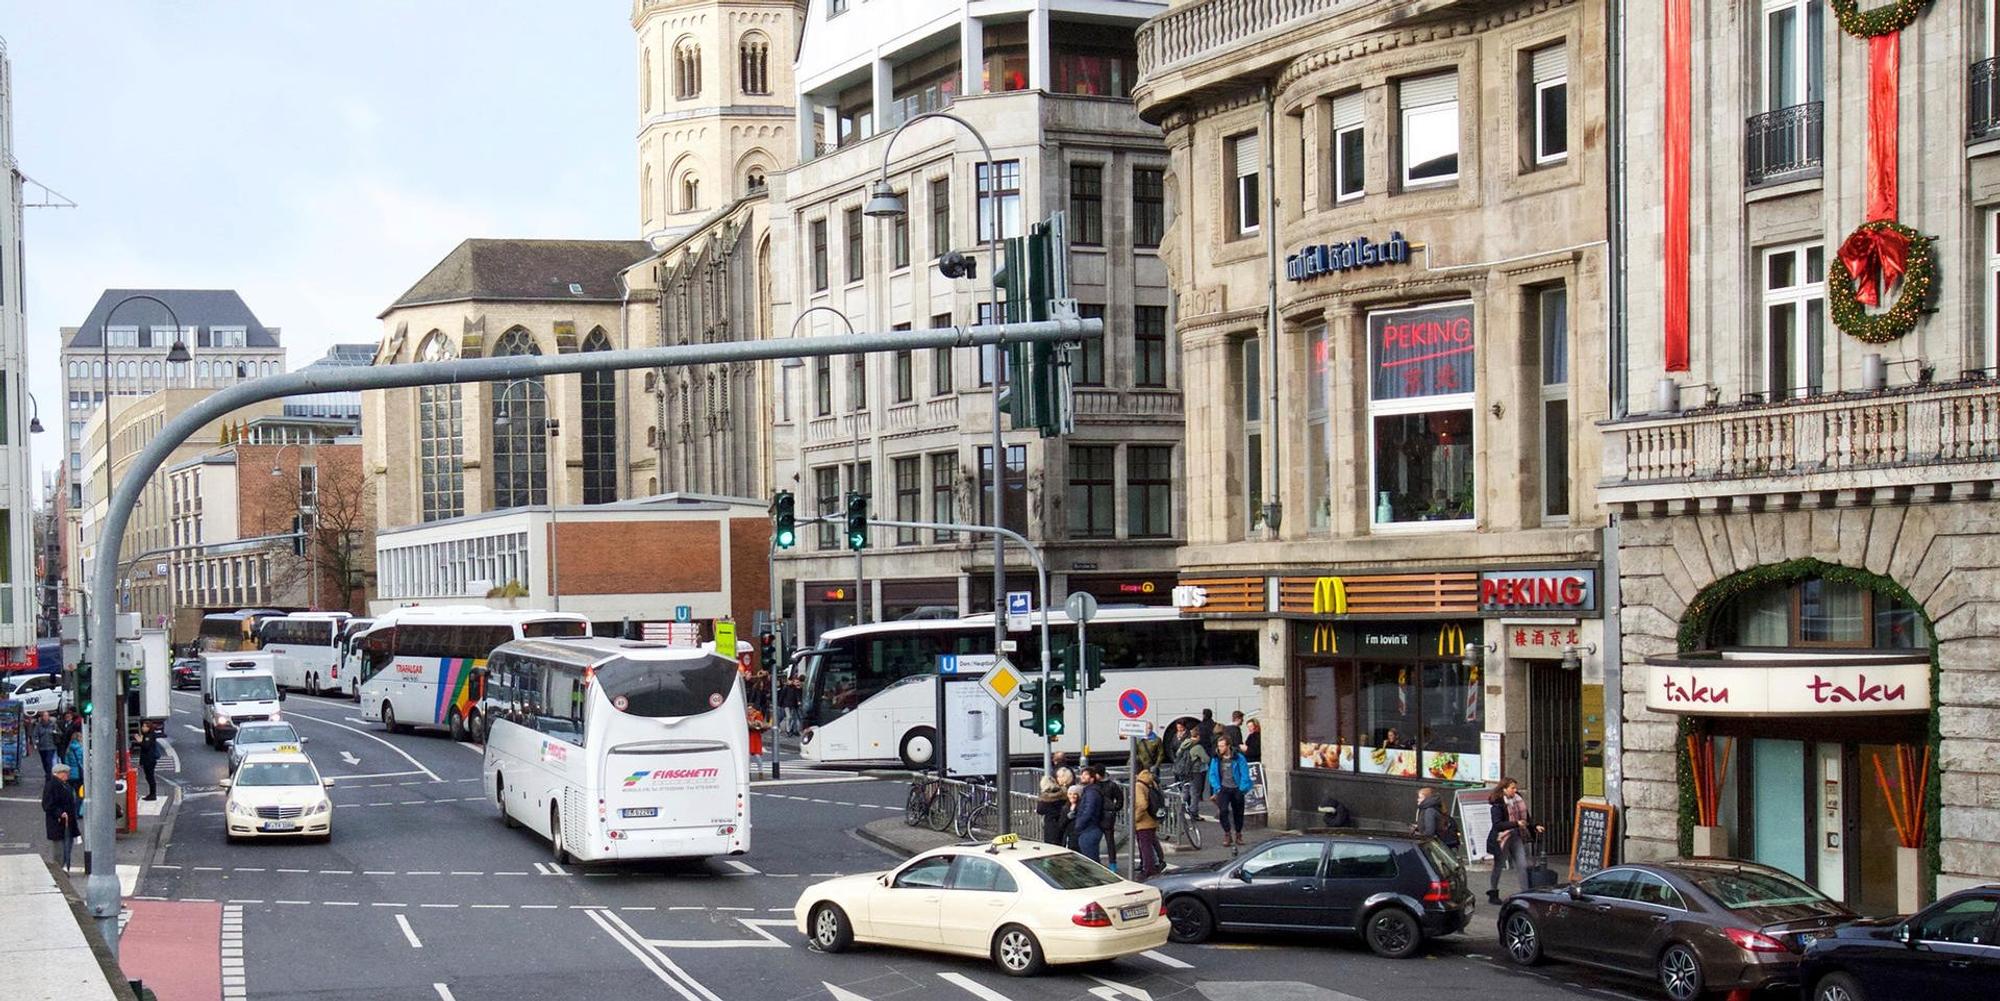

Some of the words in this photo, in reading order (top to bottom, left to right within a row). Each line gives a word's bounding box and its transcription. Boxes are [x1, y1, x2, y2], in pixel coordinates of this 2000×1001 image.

[1384, 318, 1472, 350] PEKING
[1482, 576, 1587, 606] PEKING
[1365, 634, 1379, 645] I'm
[943, 656, 955, 671] U
[1664, 674, 1729, 703] taku
[1806, 674, 1905, 703] taku
[653, 768, 719, 780] FIASCHETTI
